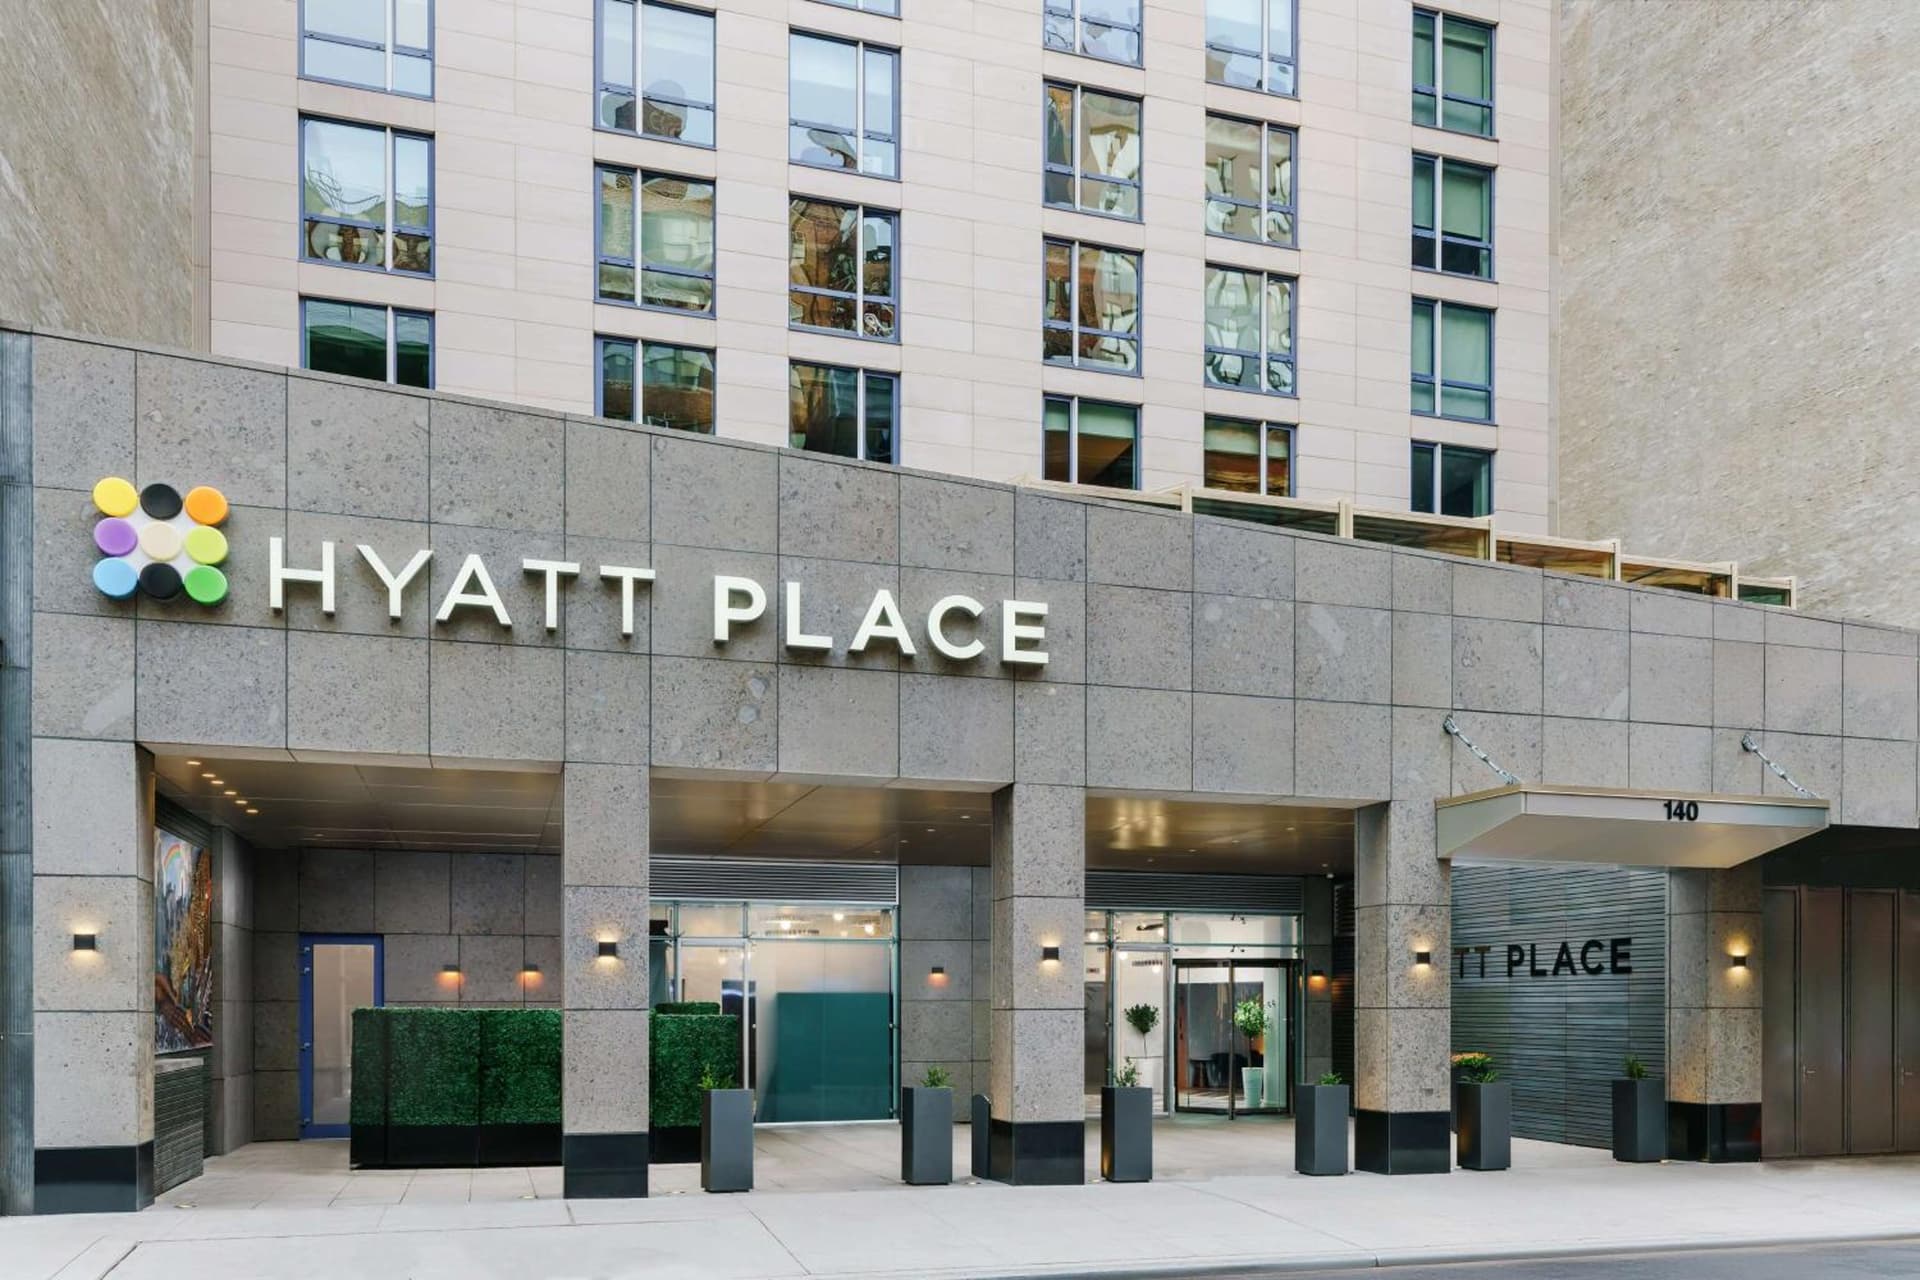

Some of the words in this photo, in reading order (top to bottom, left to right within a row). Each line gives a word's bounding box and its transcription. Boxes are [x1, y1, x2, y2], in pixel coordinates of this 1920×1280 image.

[268, 536, 657, 637] HYATT
[713, 574, 1050, 665] PLACE
[1663, 799, 1699, 821] 140
[1507, 937, 1632, 978] PLACE
